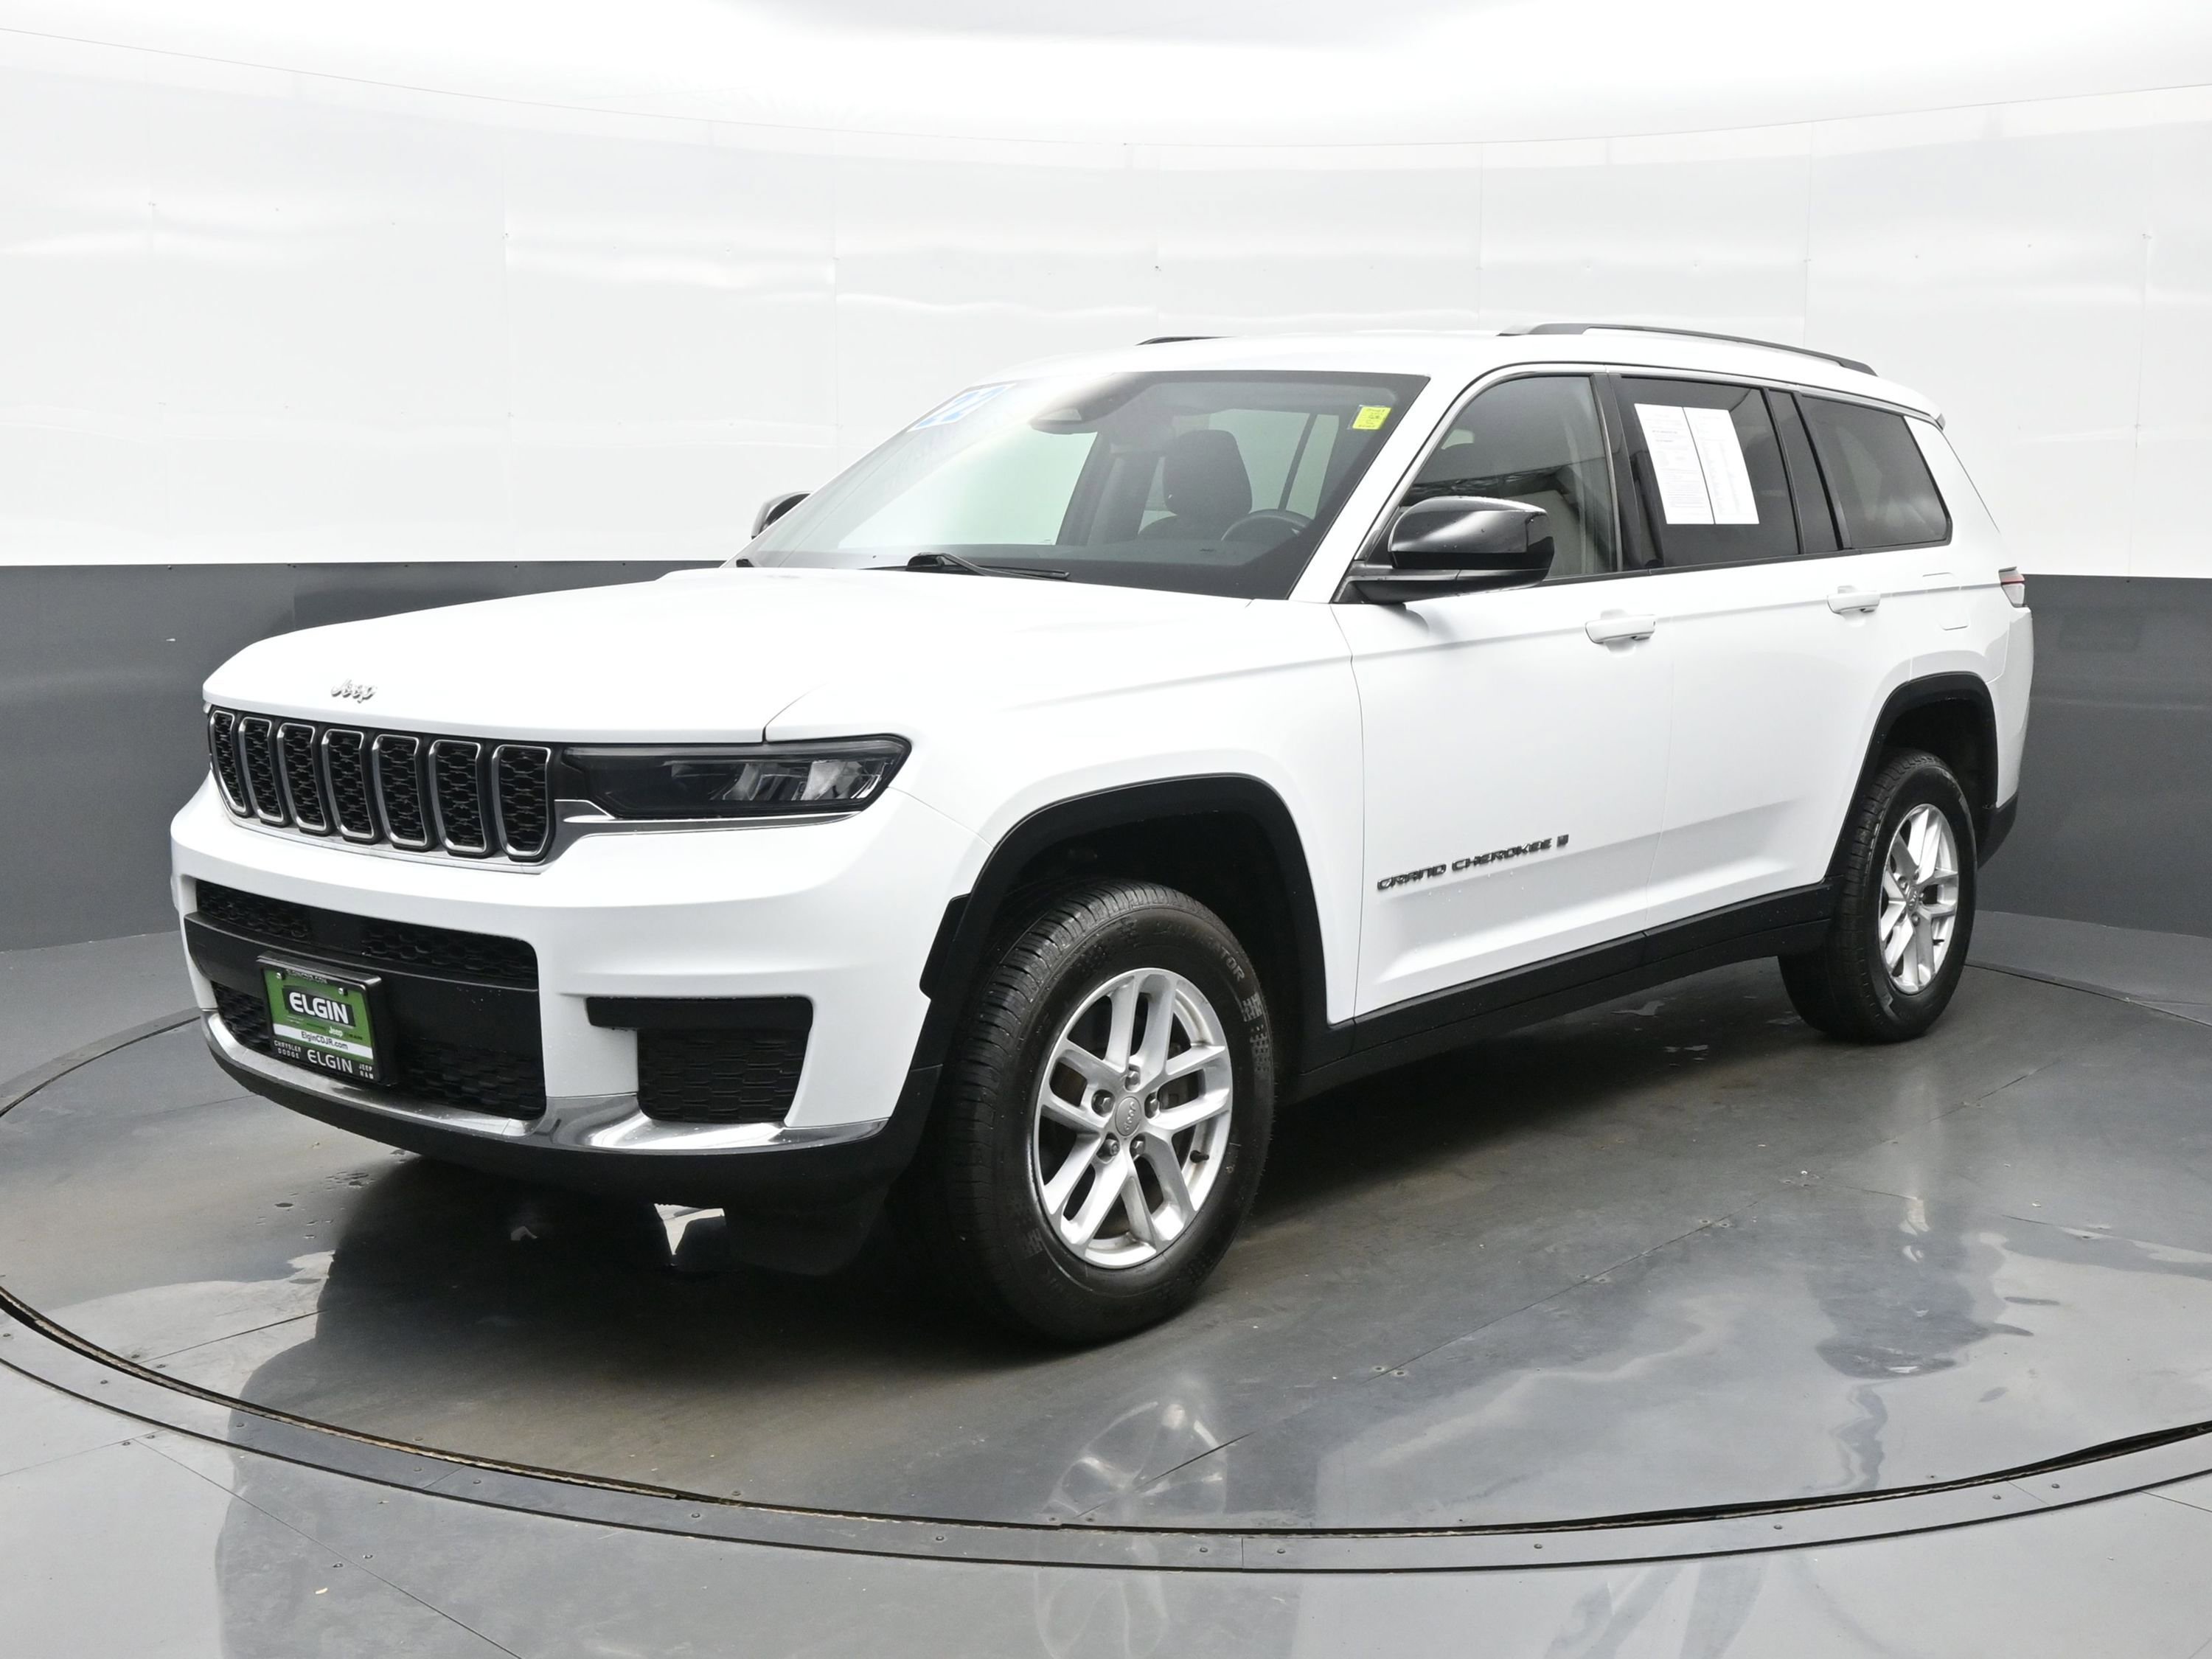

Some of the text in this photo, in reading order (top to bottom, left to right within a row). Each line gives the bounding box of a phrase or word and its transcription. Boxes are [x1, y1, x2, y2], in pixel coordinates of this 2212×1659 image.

[331, 678, 378, 703] Jeep
[1377, 864, 1447, 890] GRAND
[1451, 838, 1551, 872] CHEROKEE
[290, 992, 349, 1024] ELGIN
[301, 1031, 349, 1050] ElginCDJR.com
[307, 1049, 353, 1074] ELGIN
